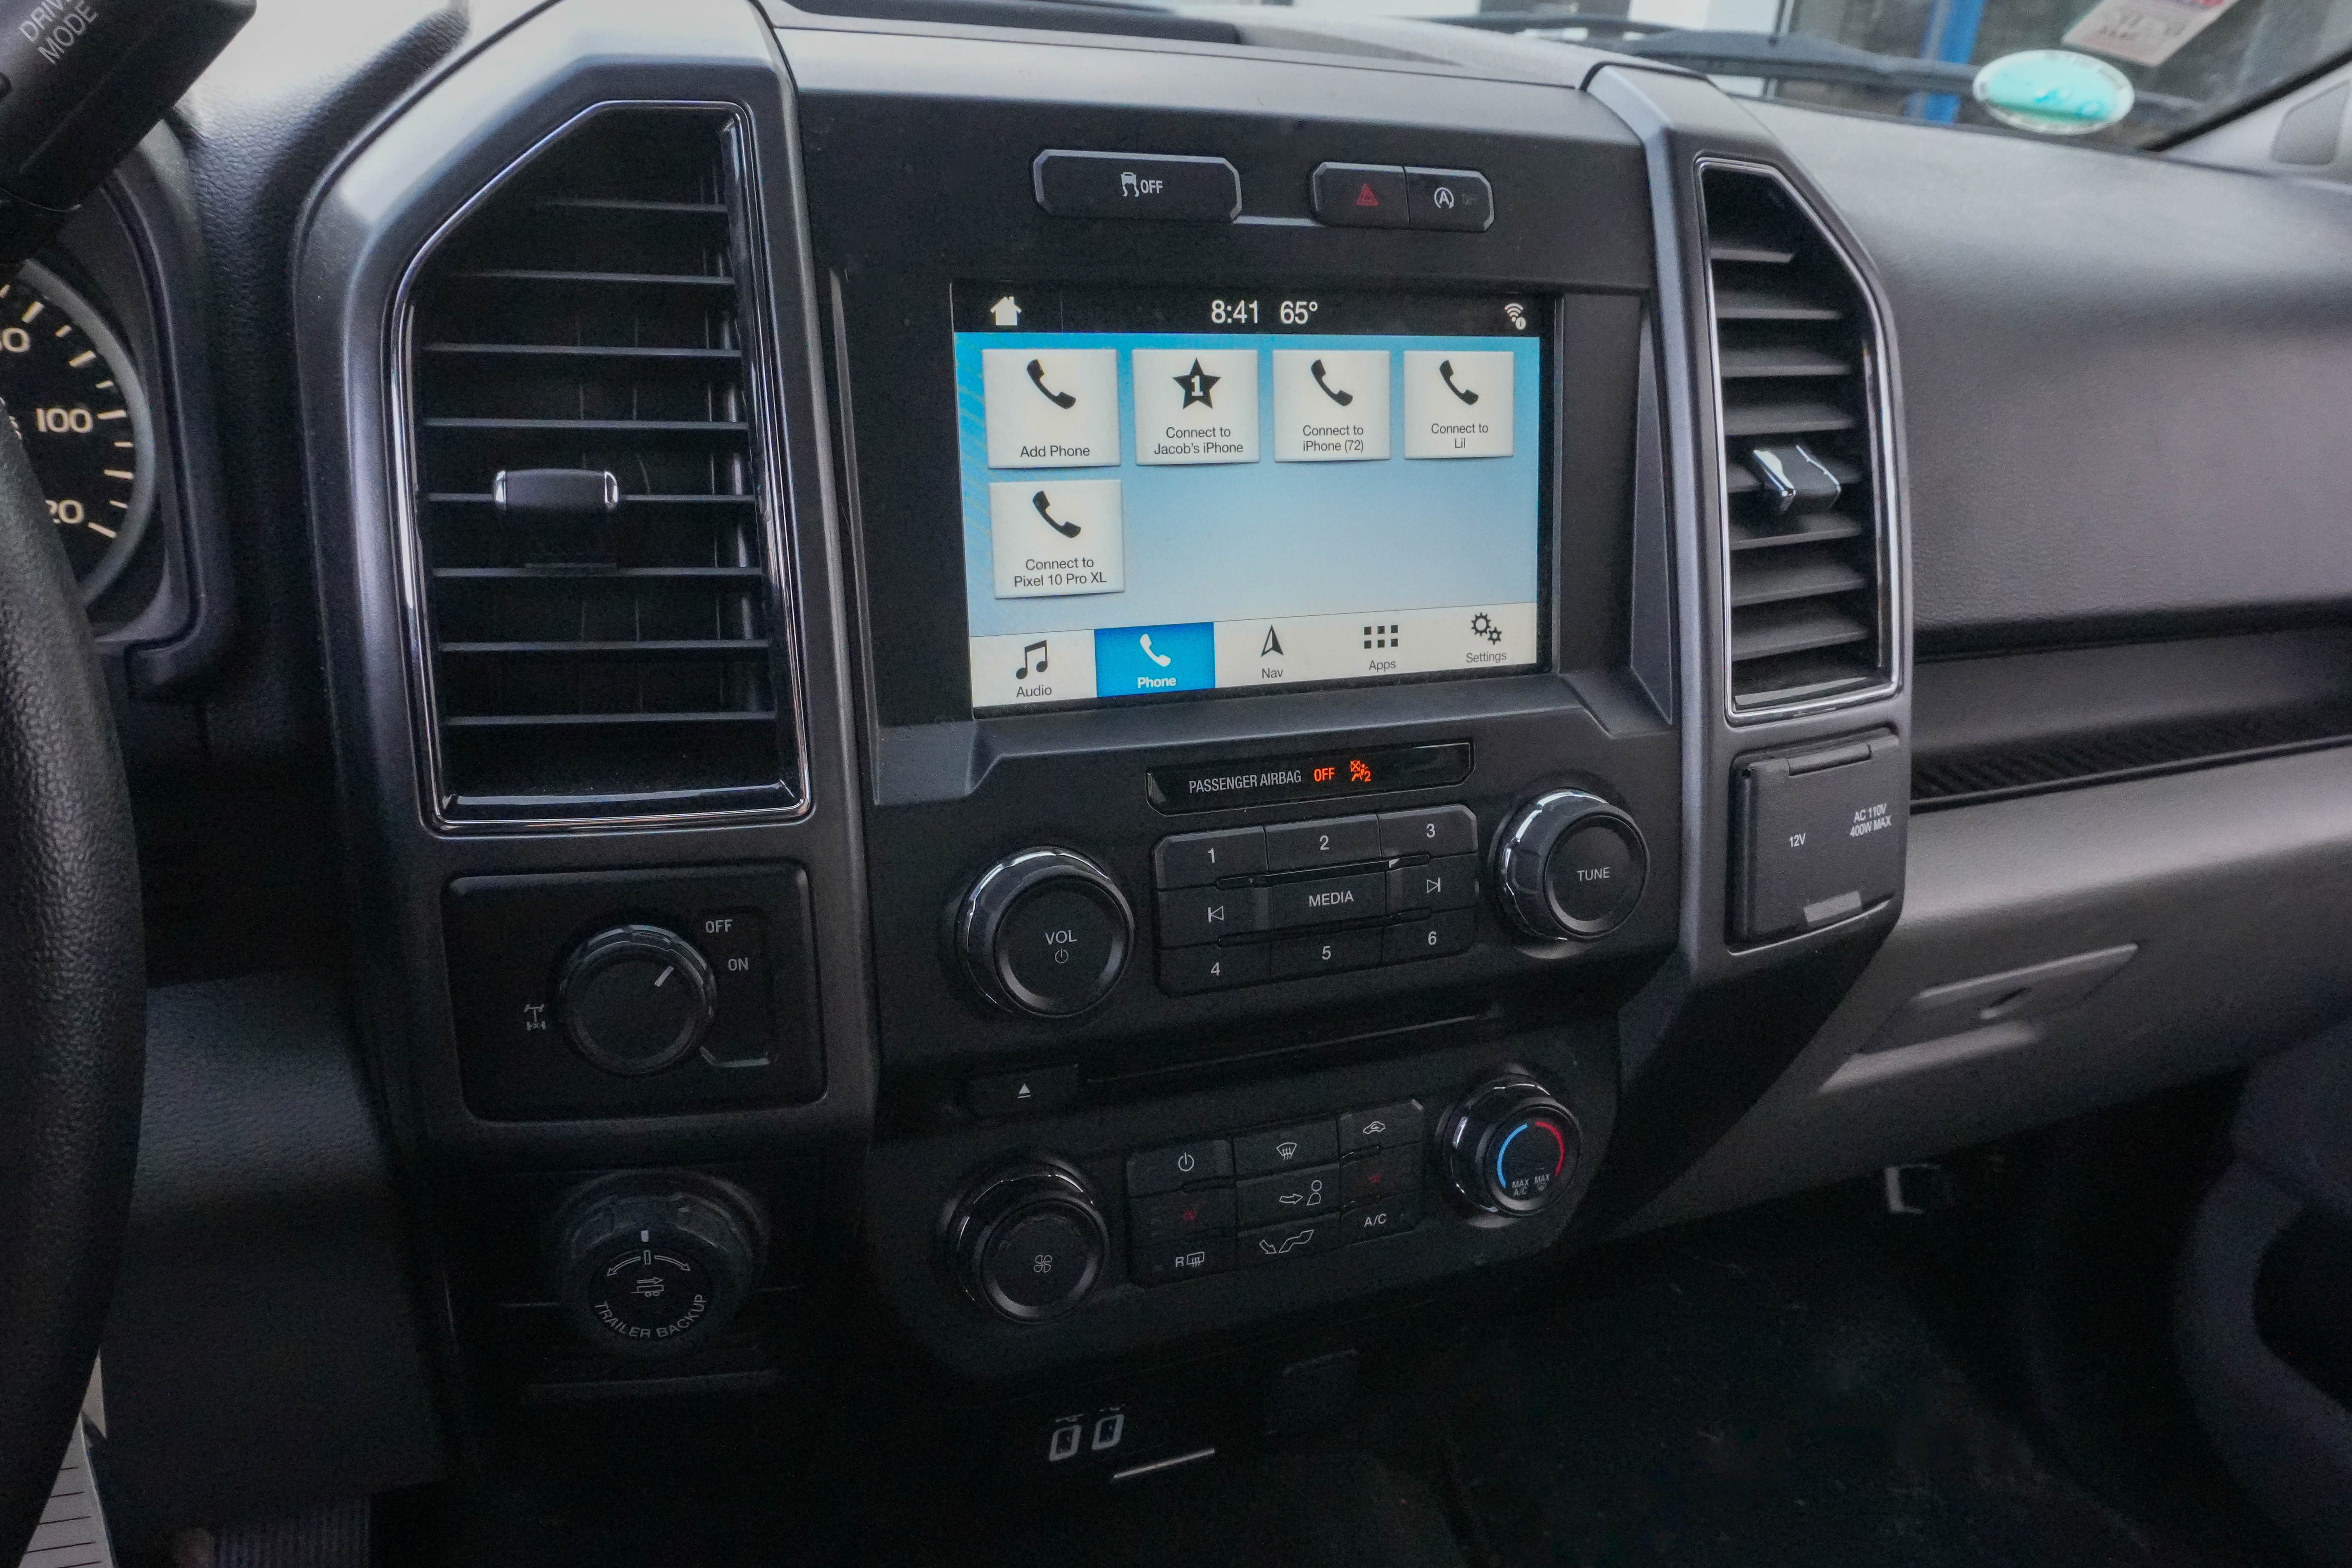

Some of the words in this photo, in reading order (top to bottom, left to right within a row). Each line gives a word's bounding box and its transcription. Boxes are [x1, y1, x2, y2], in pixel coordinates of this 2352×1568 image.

[19, 0, 73, 43] DRIV
[37, 0, 99, 64] MODE
[1140, 179, 1163, 194] OFF
[1211, 299, 1258, 324] 8:41
[1280, 300, 1318, 324] 65°
[0, 327, 31, 353] 0
[1191, 375, 1203, 396] 1
[36, 408, 93, 433] 100
[1166, 427, 1216, 439] Connect
[1220, 427, 1231, 438] to
[1302, 425, 1350, 436] Connect
[1353, 425, 1364, 435] to
[1431, 423, 1475, 435] Connect
[1478, 423, 1488, 434] to
[1154, 443, 1200, 455] Jacob's
[1203, 443, 1243, 454] iPhone
[1303, 440, 1342, 452] iPhone
[1344, 439, 1364, 452] (72)
[1454, 438, 1466, 449] Lil
[1020, 445, 1046, 458] Add
[1050, 445, 1090, 457] Phone
[45, 499, 84, 524] 20
[1025, 558, 1079, 571] Connect
[1082, 558, 1094, 568] to
[1014, 575, 1043, 587] Pixel
[1048, 575, 1062, 586] 10
[1066, 573, 1087, 585] Pro
[1090, 571, 1107, 583] XL
[1466, 652, 1507, 664] Settings
[1262, 668, 1283, 679] Nav
[1369, 660, 1396, 672] Apps
[1137, 676, 1176, 688] Phone
[1016, 685, 1052, 698] Audio
[1189, 775, 1258, 794] PASSENGER
[1260, 770, 1302, 788] AIRBAG
[1314, 767, 1335, 782] OFF
[1364, 771, 1371, 782] 2
[1854, 811, 1866, 823] AC
[1868, 803, 1887, 818] 110V
[1426, 823, 1436, 838] 3
[1850, 821, 1873, 837] 400W
[1874, 815, 1891, 831] MAX
[1319, 835, 1329, 850] 2
[1789, 833, 1806, 847] 12V
[1207, 847, 1216, 864] 1
[1577, 867, 1611, 881] TUNE
[1309, 890, 1354, 908] MEDIA
[705, 919, 733, 933] OFF
[1045, 929, 1078, 945] VOL
[1427, 931, 1437, 946] 6
[1322, 945, 1331, 960] 5
[728, 957, 749, 971] ON
[1210, 962, 1221, 977] 4
[1512, 1179, 1529, 1189] MAX
[1535, 1174, 1550, 1183] MAX
[1513, 1188, 1527, 1196] A/C
[1363, 1213, 1386, 1228] A/C
[1175, 1256, 1184, 1267] R
[595, 1301, 651, 1338] TRAILER
[656, 1294, 707, 1338] BACKUP
